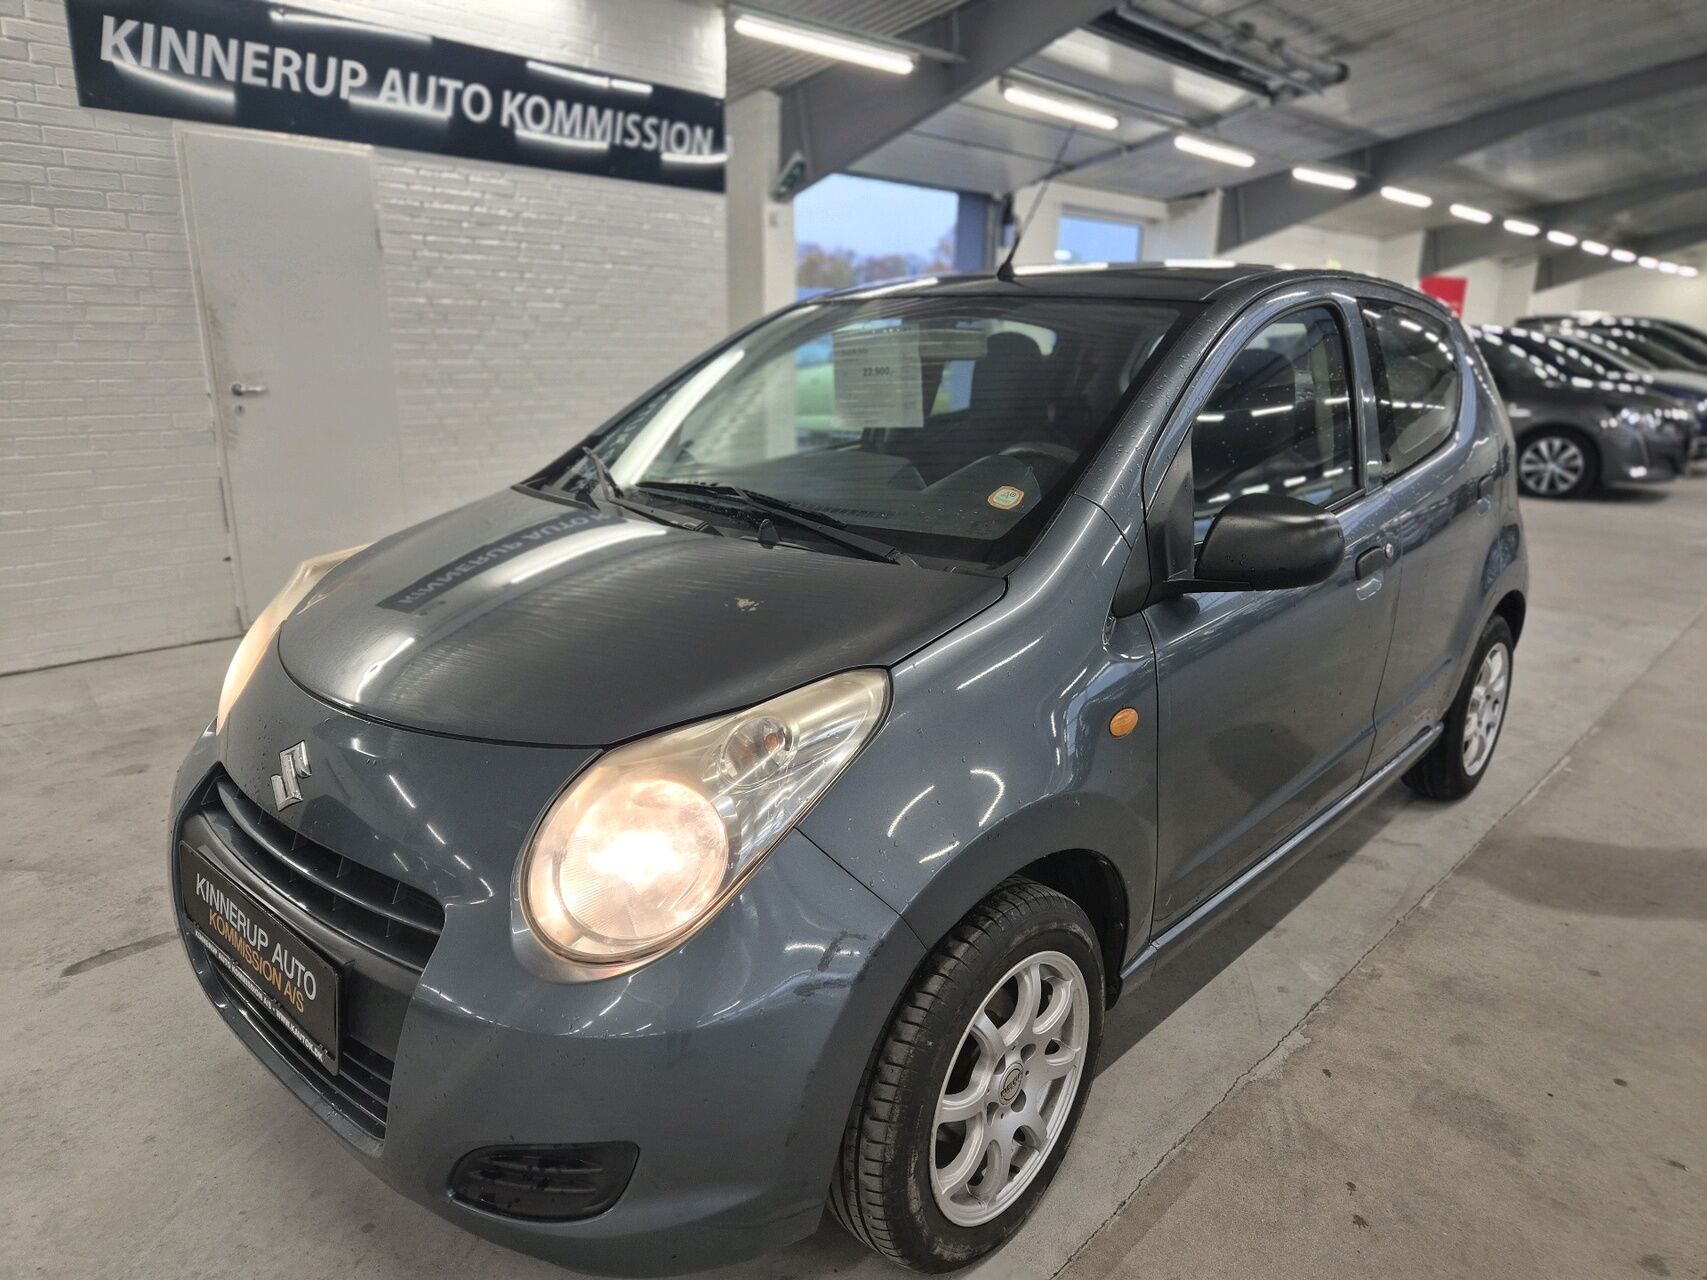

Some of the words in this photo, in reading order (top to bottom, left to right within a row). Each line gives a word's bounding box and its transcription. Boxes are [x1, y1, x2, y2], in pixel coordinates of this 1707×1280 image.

[100, 14, 368, 100] KINNERUP
[377, 68, 492, 122] AUTO
[500, 89, 714, 156] KOMMISSION
[195, 873, 269, 950] KINNERUP
[271, 942, 317, 1000] AUTO
[208, 911, 282, 992] KOMMISSION
[284, 983, 305, 1014] A/S
